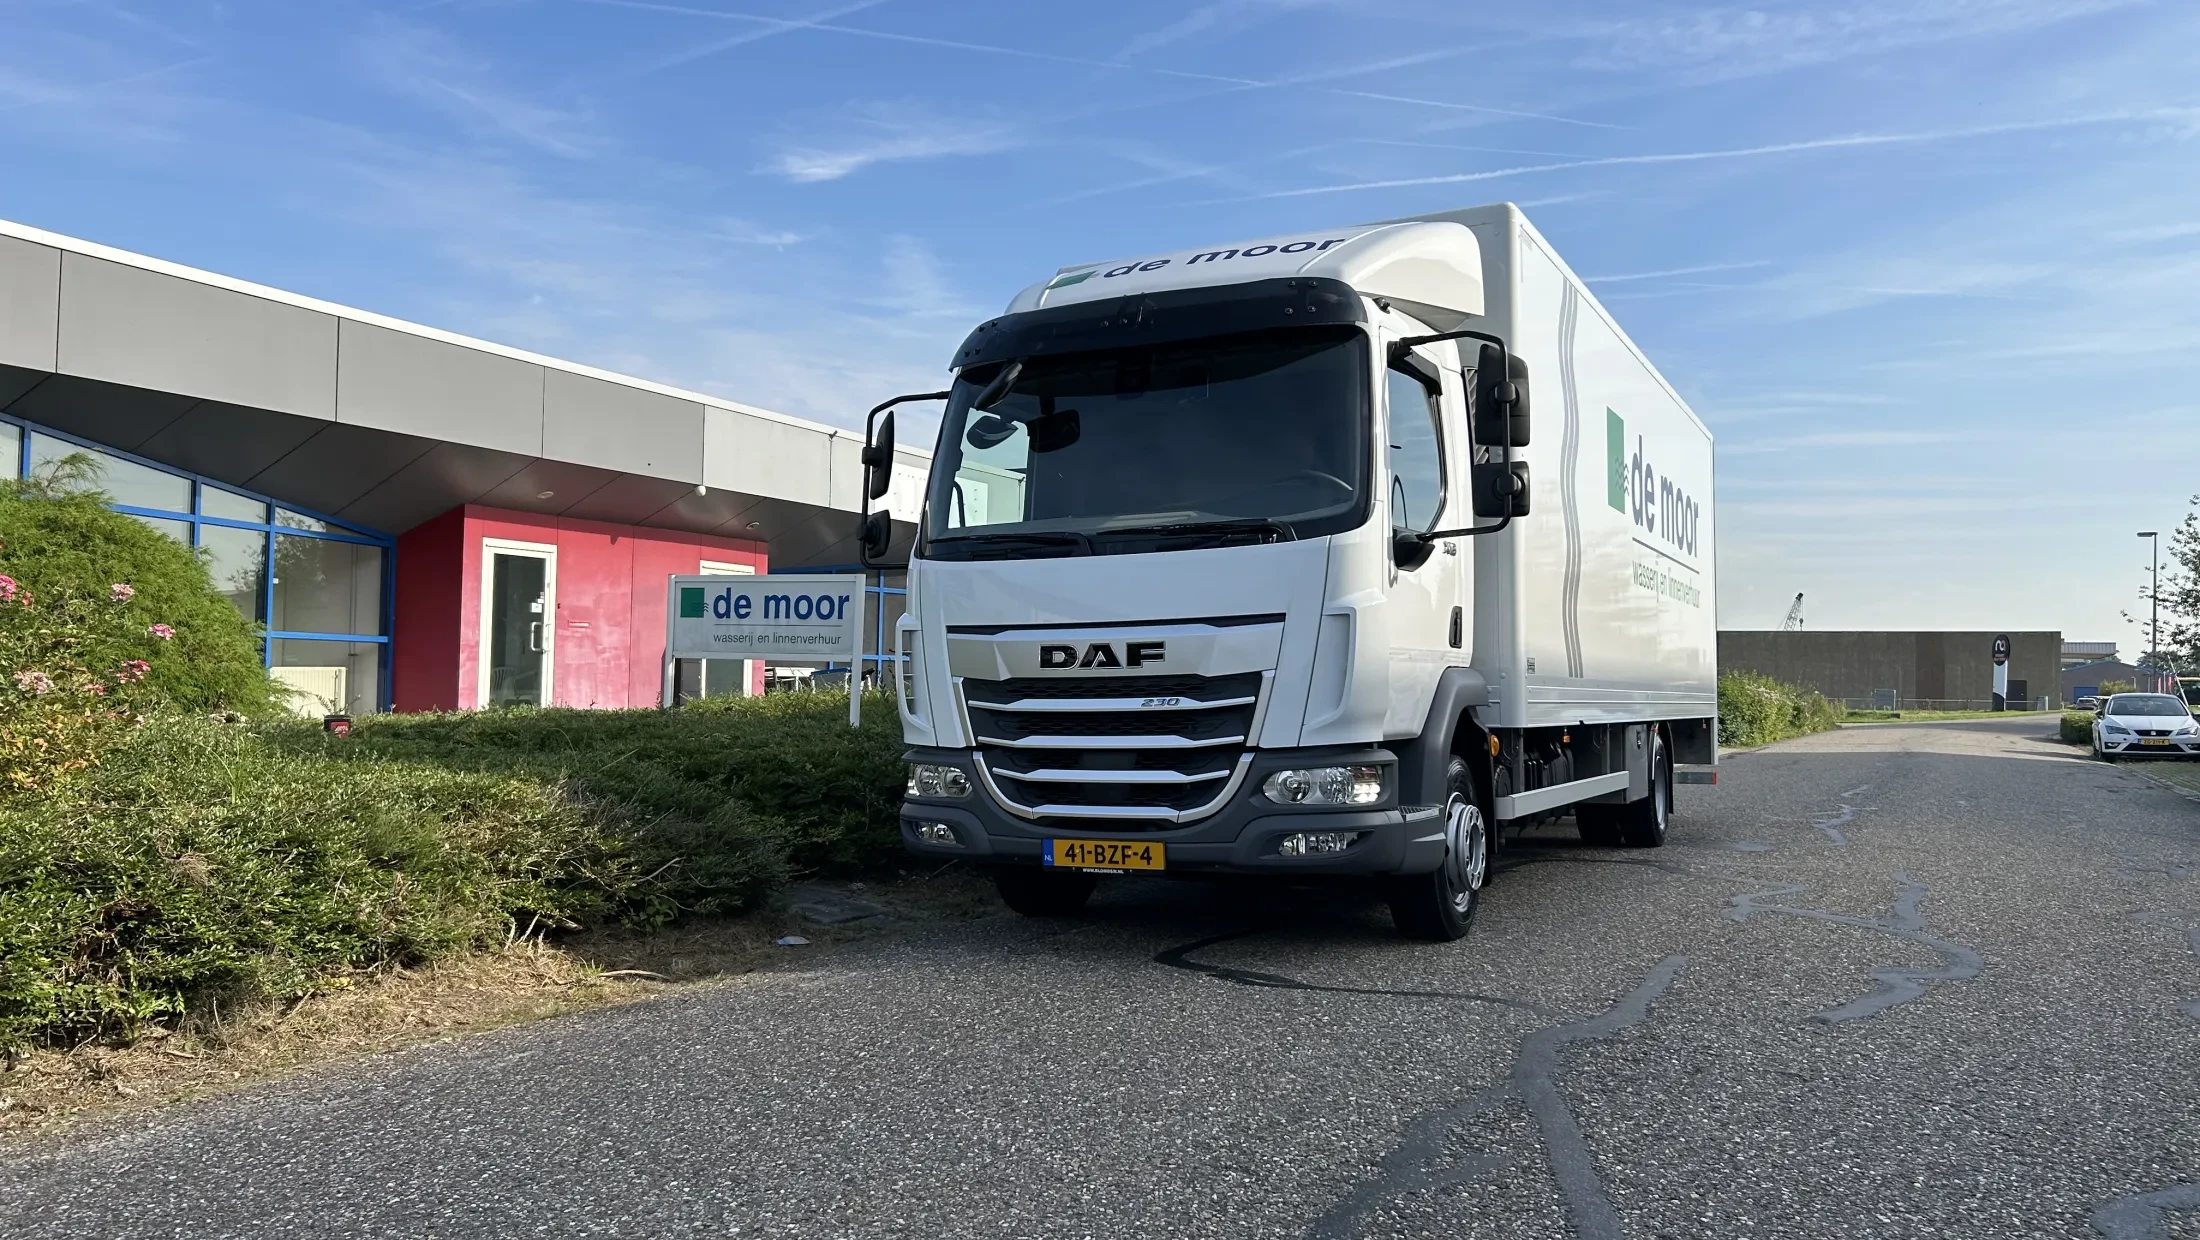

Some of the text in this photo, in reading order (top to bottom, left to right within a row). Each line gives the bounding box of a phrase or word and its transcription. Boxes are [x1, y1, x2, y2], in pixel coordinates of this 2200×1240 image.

[1103, 238, 1346, 279] de moor
[1631, 434, 1699, 558] de moor
[1660, 573, 1668, 596] en
[713, 587, 850, 620] de moor
[713, 632, 842, 646] wasserij en linnenverhuur
[1039, 640, 1167, 670] DAF
[1141, 697, 1181, 708] 230
[1044, 843, 1153, 866] NL 41-BZF-4
